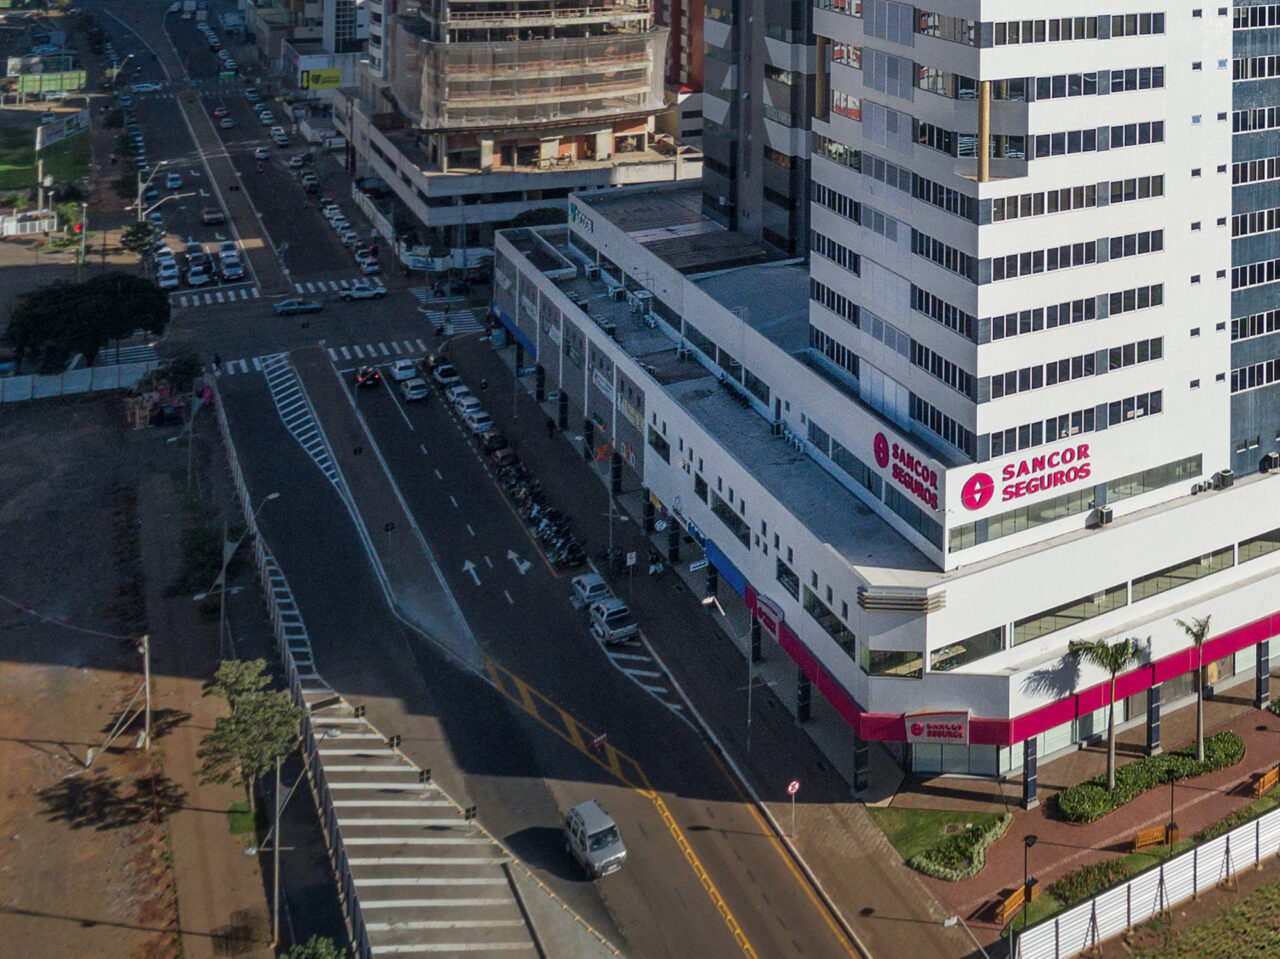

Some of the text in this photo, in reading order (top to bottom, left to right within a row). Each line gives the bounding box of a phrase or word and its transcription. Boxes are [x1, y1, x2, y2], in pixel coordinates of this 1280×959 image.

[891, 443, 938, 490] SANCOR
[1002, 444, 1090, 481] SANCOR
[1002, 463, 1091, 502] SEGUROS
[891, 463, 938, 511] SEGUROS
